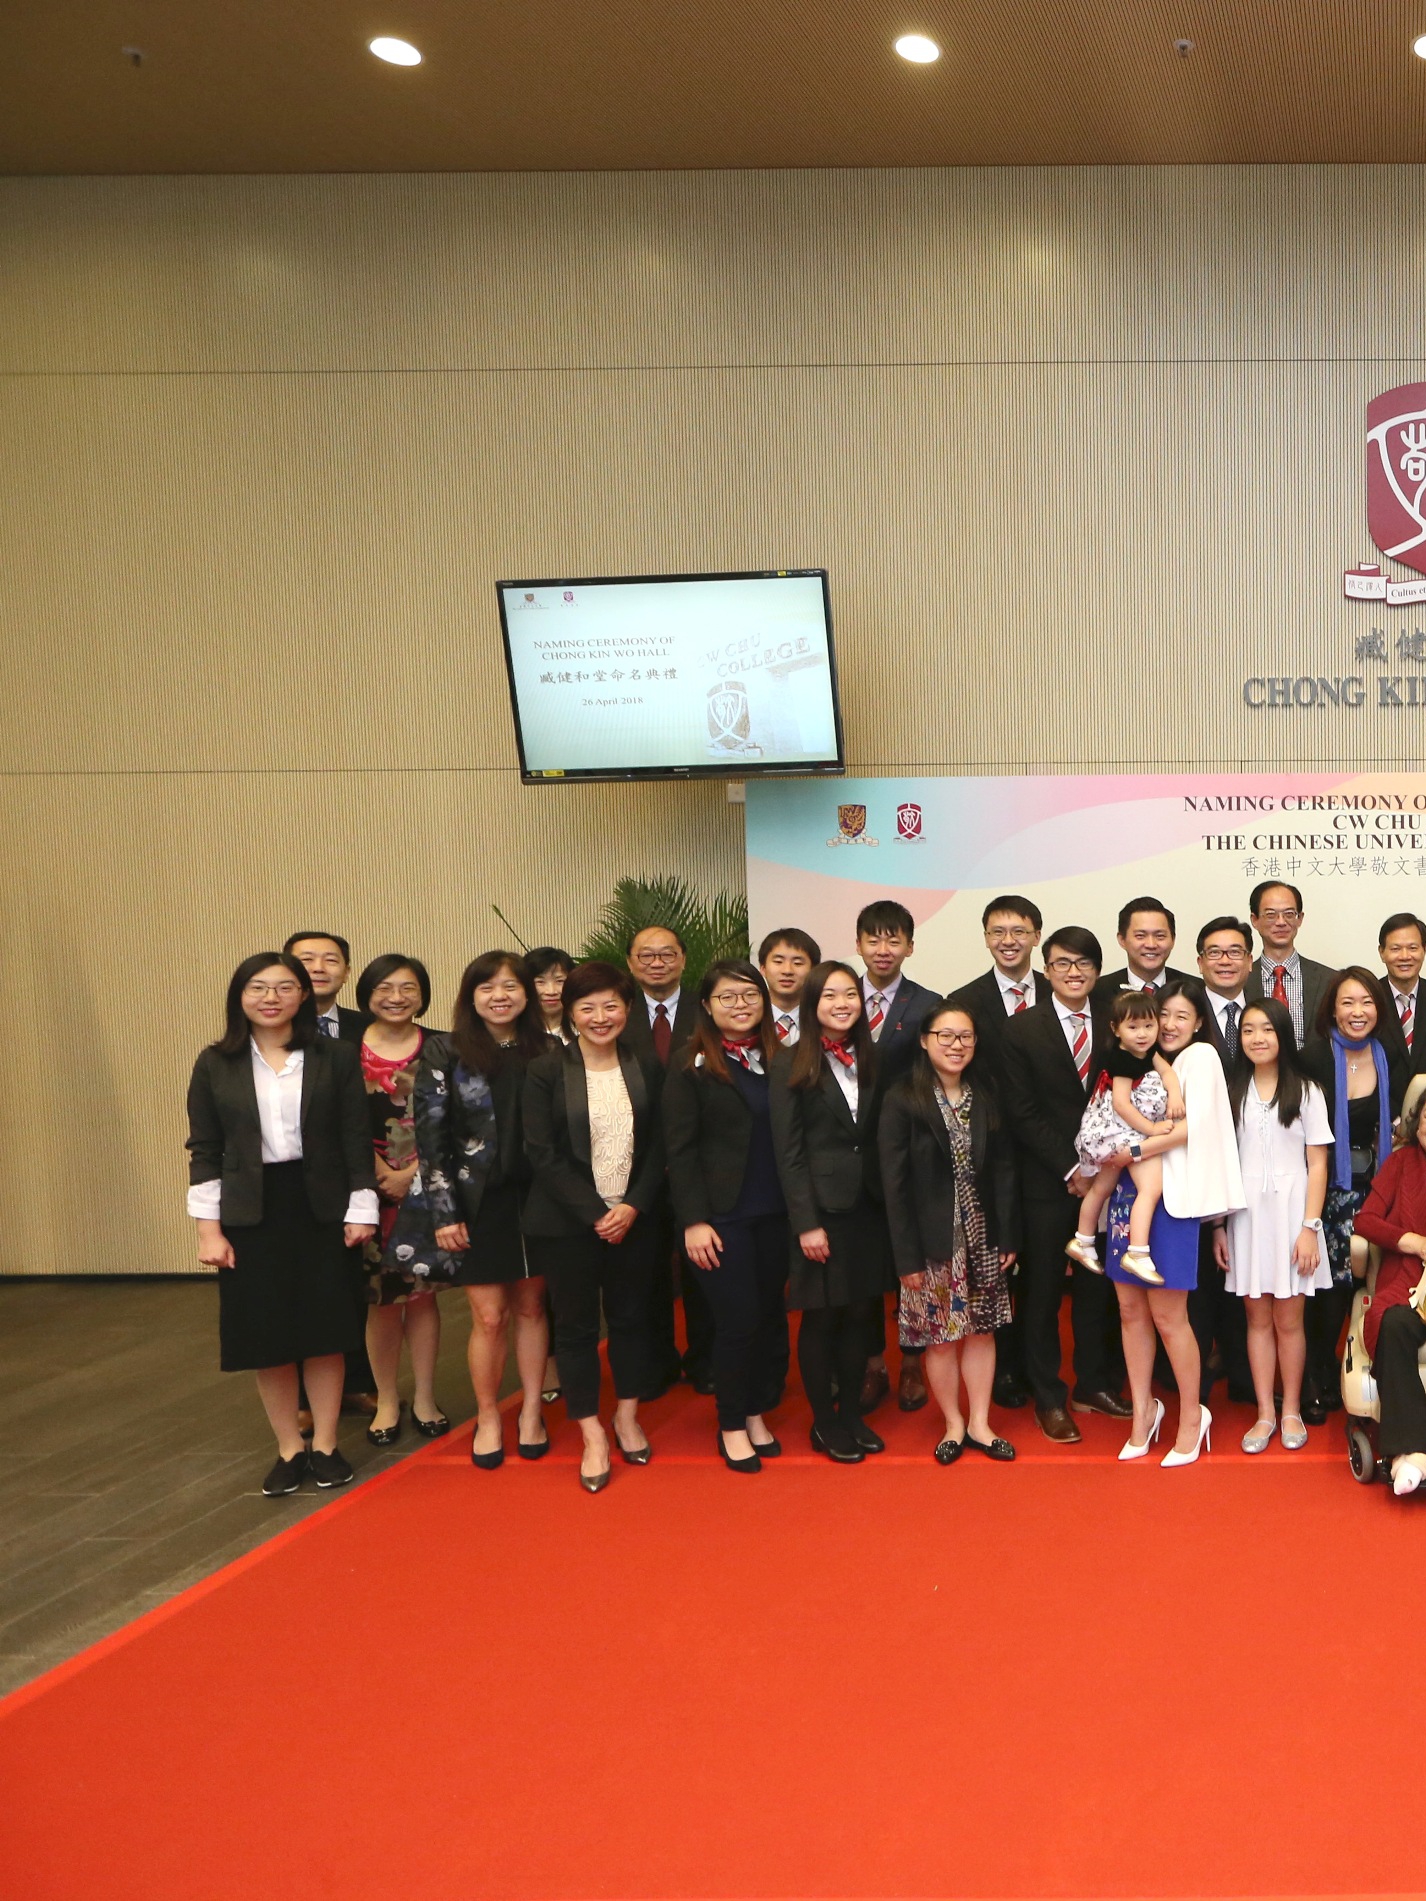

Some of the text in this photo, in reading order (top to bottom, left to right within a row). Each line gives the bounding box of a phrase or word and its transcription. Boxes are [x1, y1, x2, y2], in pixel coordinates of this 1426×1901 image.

[1390, 588, 1417, 598] Cultus
[1419, 587, 1426, 595] et
[533, 636, 675, 650] NAMING CEREMONY OF
[725, 632, 761, 657] CHU
[541, 648, 671, 661] CHONG KIN WO HALL
[717, 637, 811, 678] COLLEGE
[1243, 676, 1367, 708] CHONG
[582, 696, 644, 707] 26 April 2018
[1184, 795, 1275, 812] NAMING
[1281, 794, 1409, 812] CEREMONY
[1332, 814, 1369, 830] CW
[1375, 814, 1421, 830] CHU
[1202, 834, 1247, 851] THE
[1252, 834, 1349, 851] CHINESE
